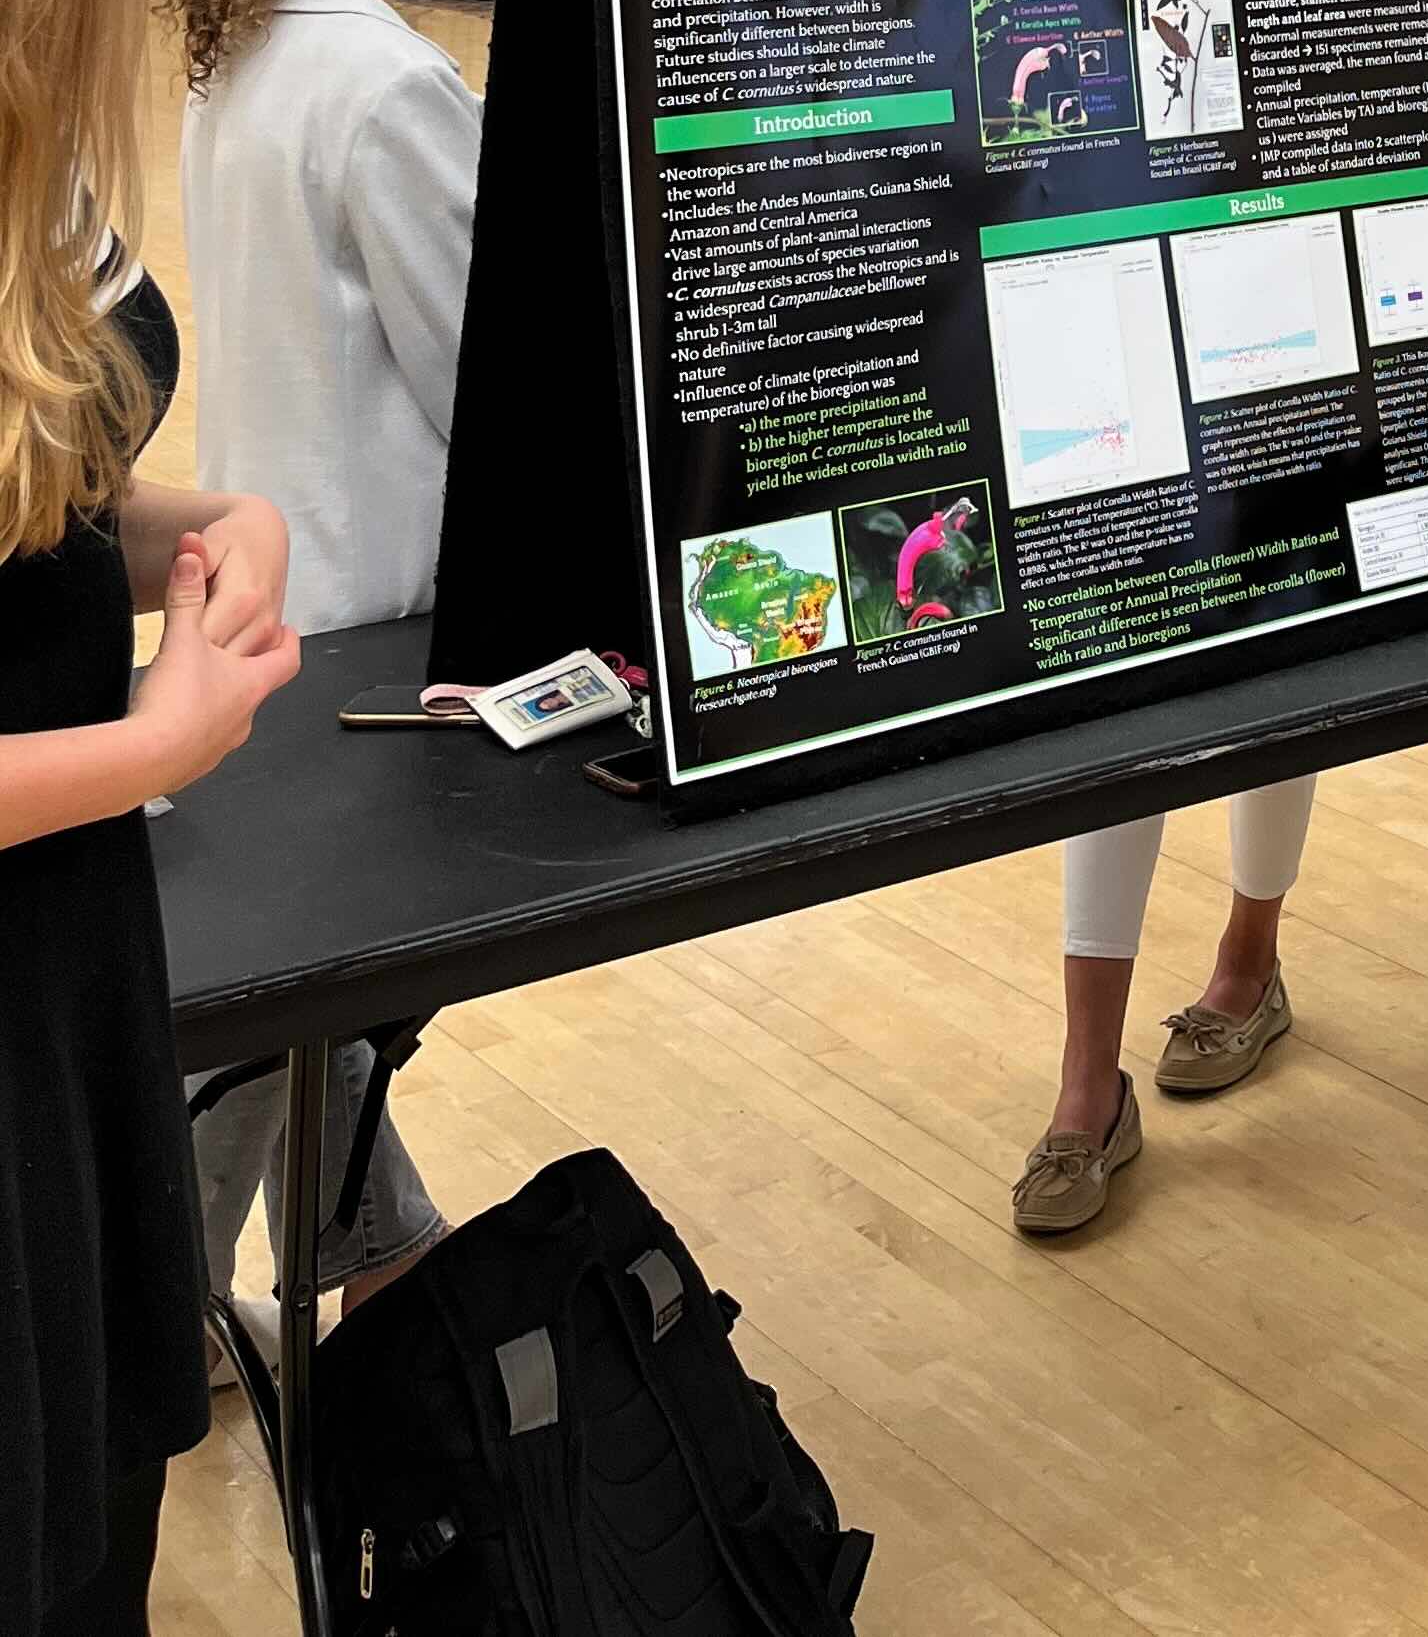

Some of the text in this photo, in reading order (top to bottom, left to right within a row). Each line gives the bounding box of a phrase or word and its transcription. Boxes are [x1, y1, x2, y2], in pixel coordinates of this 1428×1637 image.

[754, 108, 873, 134] Introduction
[665, 139, 942, 182] Neotropics are the most biodiverse region in
[667, 180, 735, 202] the world
[736, 199, 758, 213] the
[759, 194, 799, 210] Andes
[801, 187, 868, 205] Mountains,
[869, 182, 911, 196] Guiana
[1228, 193, 1284, 215] Results
[1025, 526, 1339, 612] No correlation between Corolla (Flower) Width Ratio and
[1029, 573, 1242, 631] Temperature or Annual Precipitation
